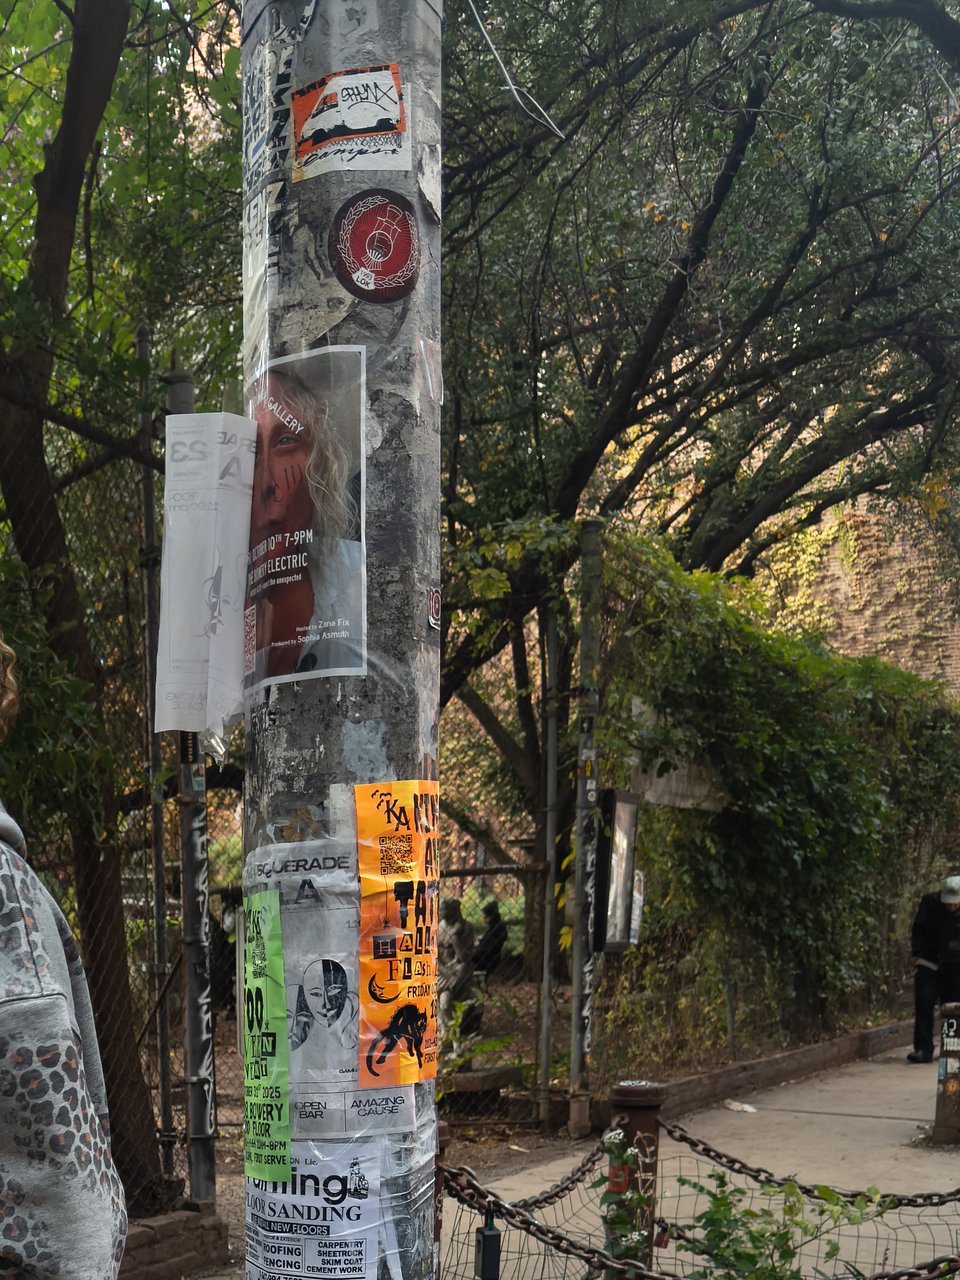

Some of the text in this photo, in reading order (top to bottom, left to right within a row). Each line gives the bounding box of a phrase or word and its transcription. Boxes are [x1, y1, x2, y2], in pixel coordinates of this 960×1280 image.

[341, 81, 398, 105] SPHYNX
[356, 275, 370, 289] LOK
[268, 396, 304, 434] GALLERY
[284, 529, 313, 547] 7-9PM
[268, 552, 308, 573] ELECTRIC
[276, 573, 302, 584] unexpected
[337, 618, 350, 627] Fix
[297, 634, 320, 644] Sophia
[321, 630, 350, 640] Asmuth
[263, 1086, 281, 1098] 2025
[294, 1101, 327, 1110] OPEN
[351, 1096, 405, 1109] AMAZING
[250, 1102, 283, 1121] BOWERY
[300, 1110, 324, 1119] BAR
[358, 1105, 399, 1117] CAUSE
[253, 1121, 271, 1138] FLOOR
[264, 1155, 287, 1165] SERVE
[246, 1192, 362, 1222] LOOR SANDING
[271, 1221, 291, 1232] NEW
[292, 1224, 328, 1236] FLOORS
[264, 1243, 301, 1257] ROOFING
[318, 1241, 364, 1249] CARPENTRY
[317, 1250, 363, 1258] SHEETROCK
[264, 1256, 301, 1270] FENCING
[321, 1258, 363, 1266] SKIM COAT
[306, 1265, 363, 1274] CEMENT WORK
